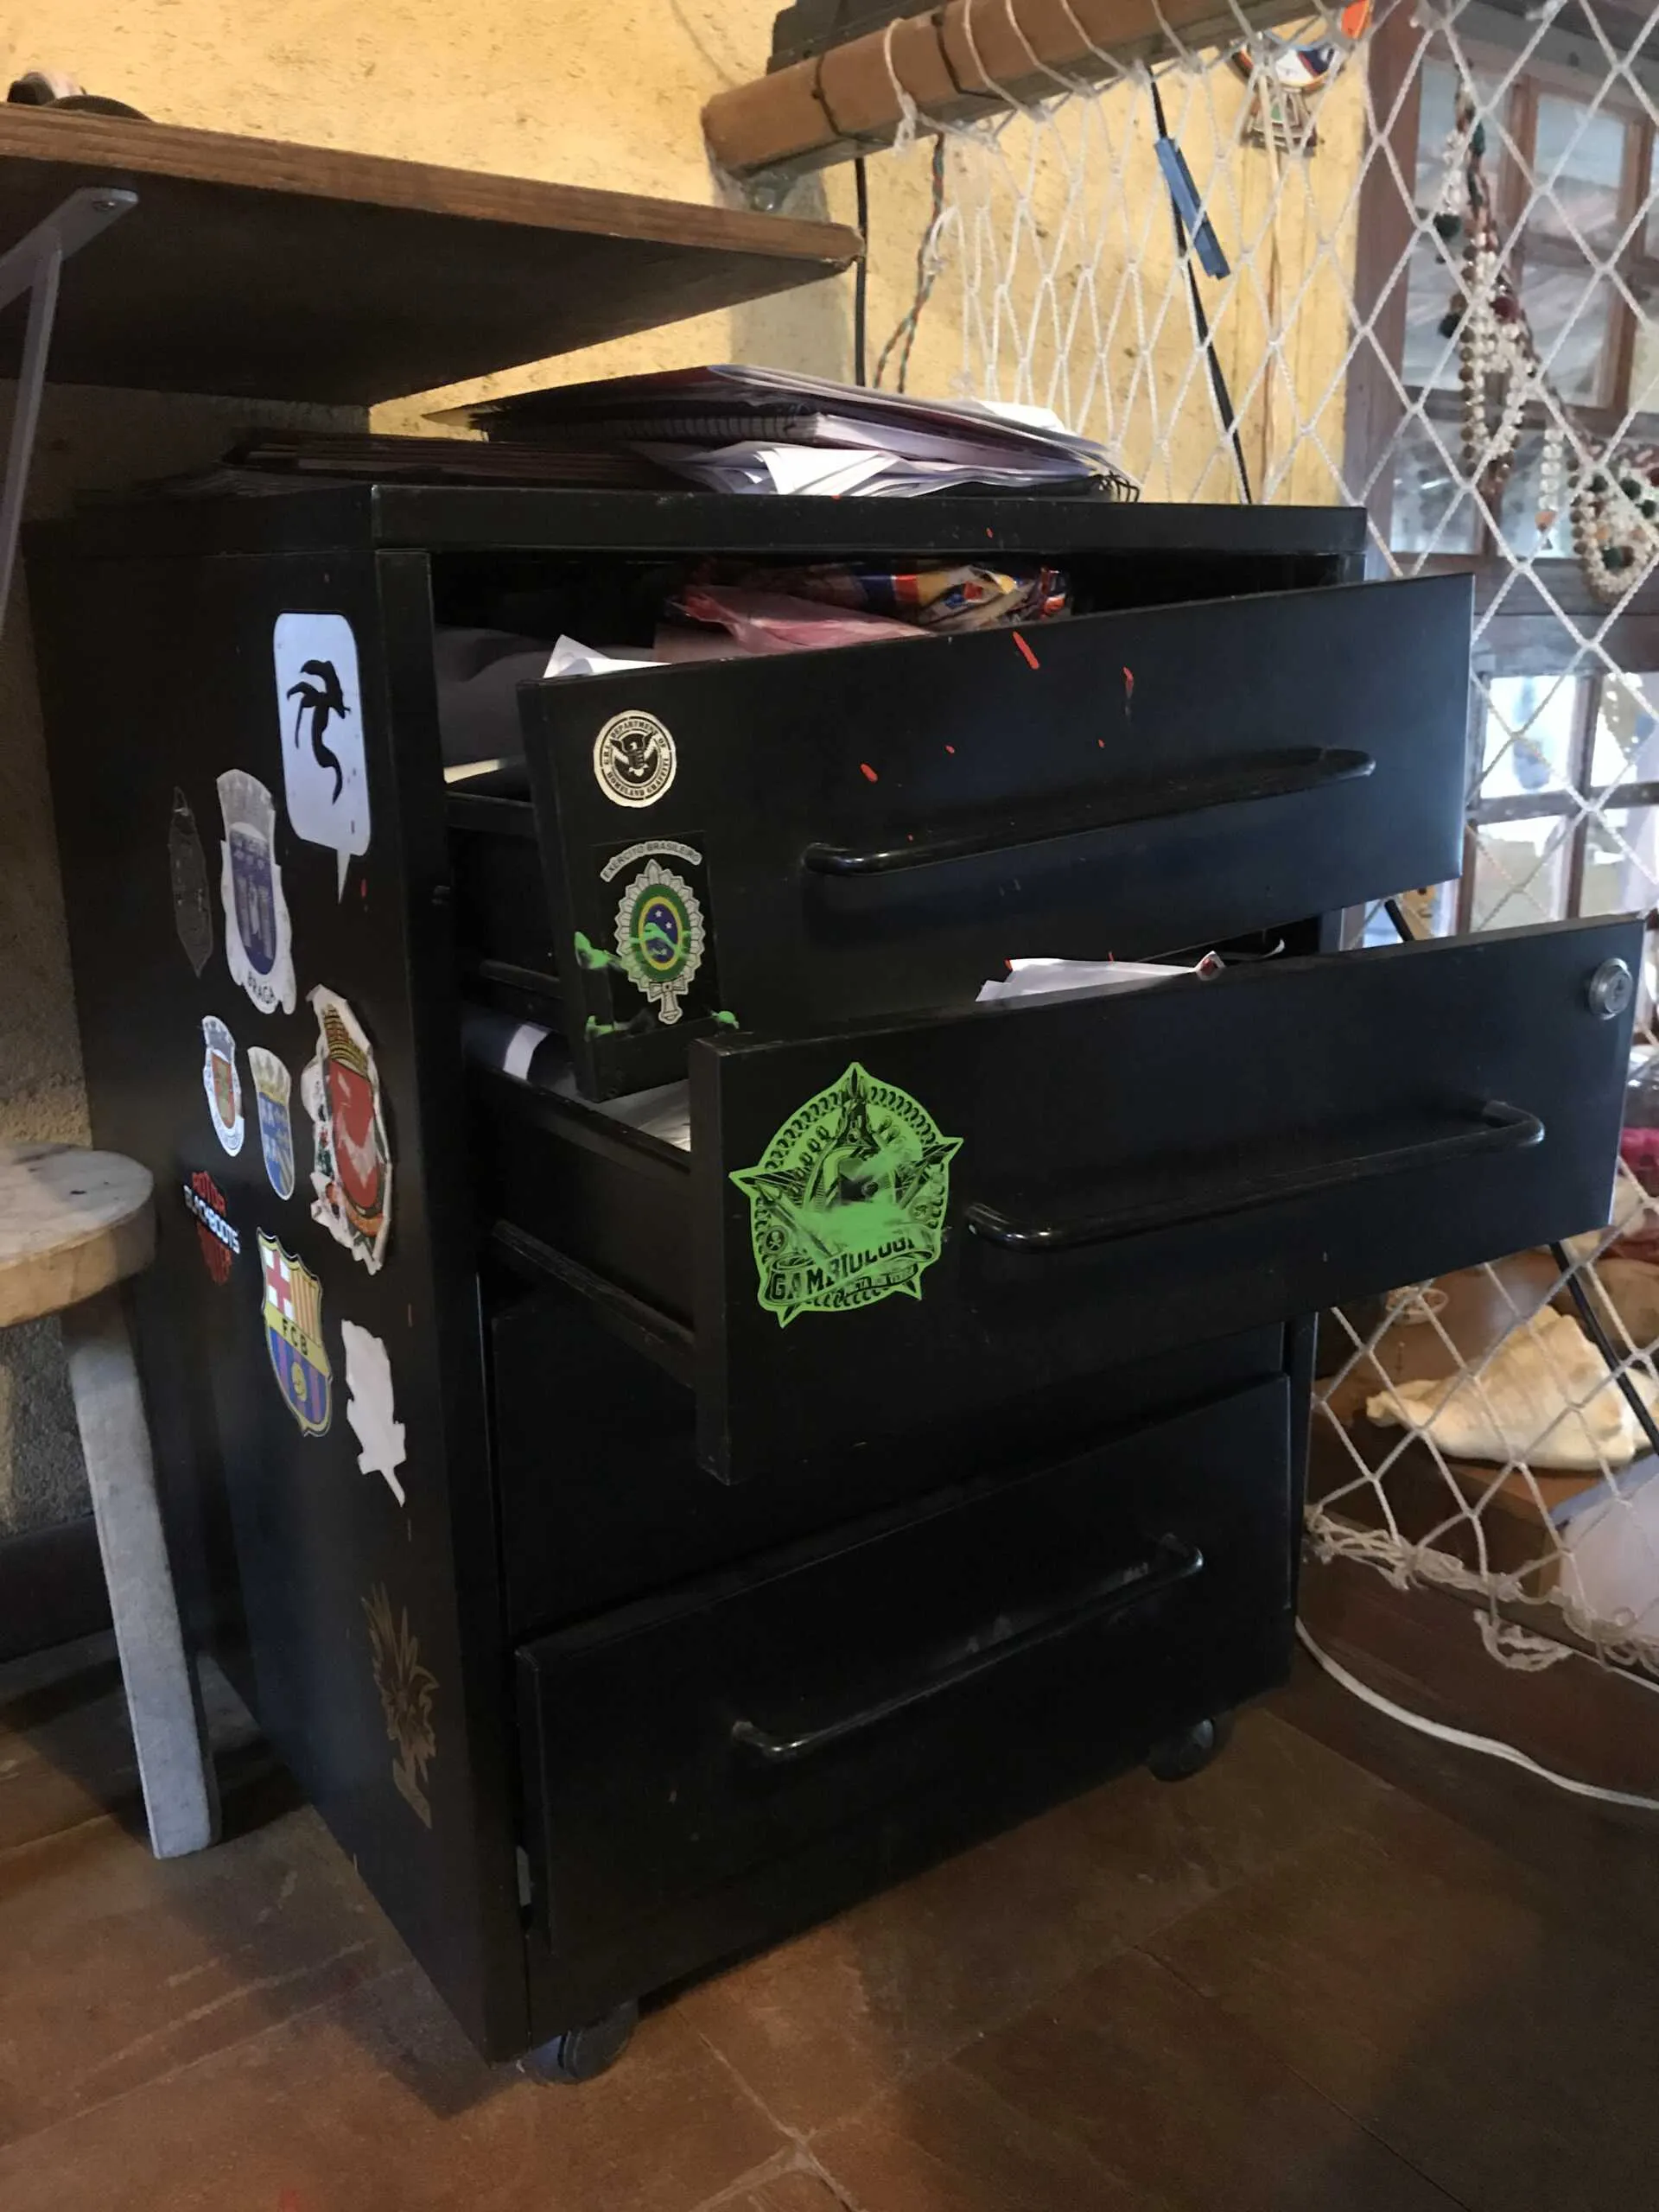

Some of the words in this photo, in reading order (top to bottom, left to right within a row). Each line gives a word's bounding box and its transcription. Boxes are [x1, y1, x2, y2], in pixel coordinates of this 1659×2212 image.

[606, 771, 645, 796] HOMELAND
[645, 841, 700, 862] BRASILEIRO
[281, 1316, 309, 1356] FCB
